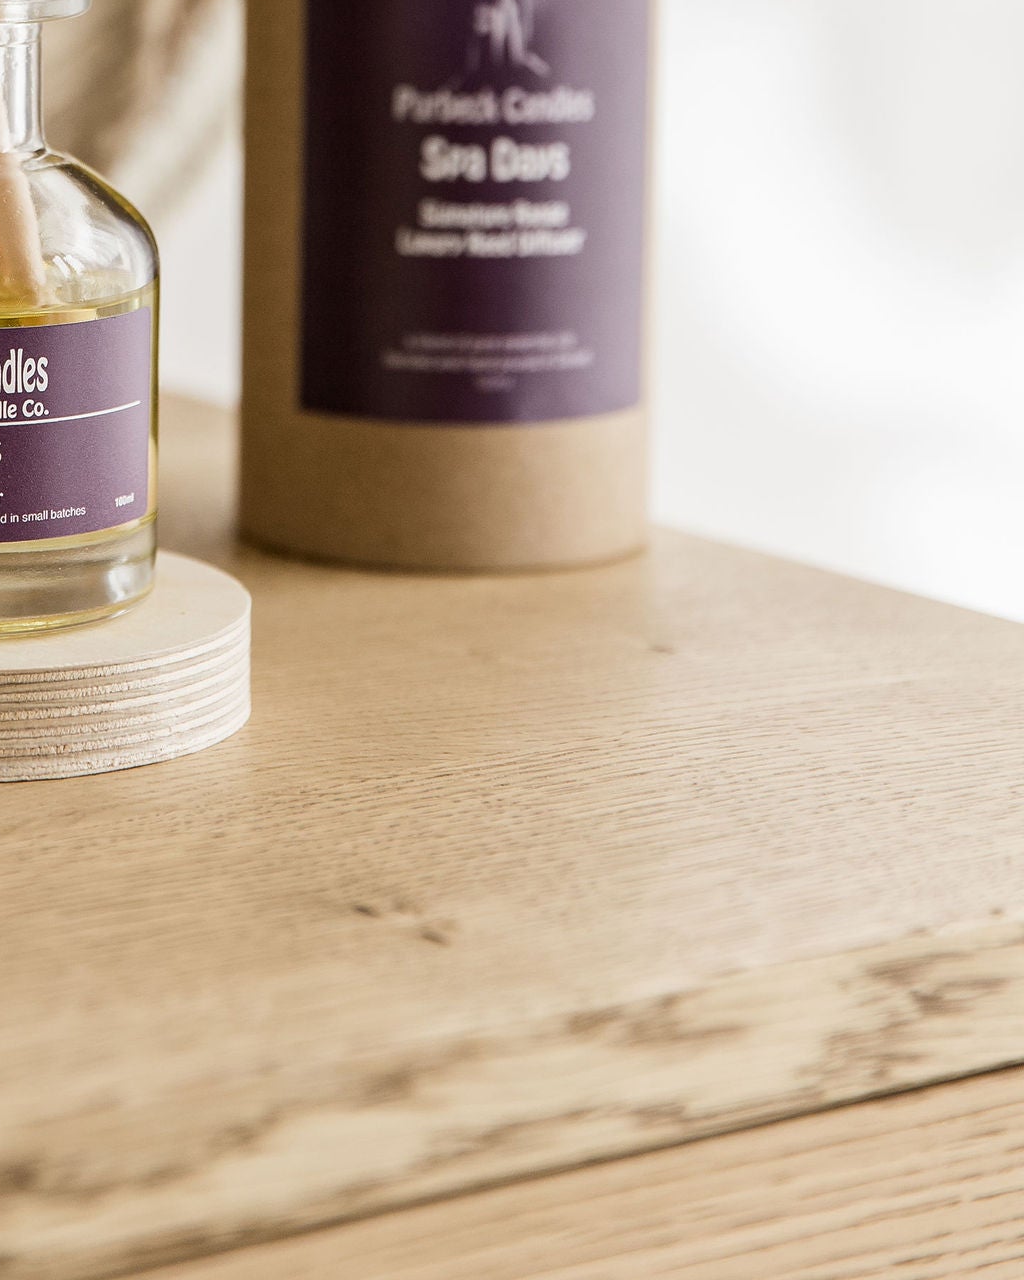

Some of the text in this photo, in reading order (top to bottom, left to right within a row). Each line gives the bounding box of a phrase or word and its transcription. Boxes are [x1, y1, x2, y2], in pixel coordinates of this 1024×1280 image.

[421, 135, 486, 181] Spa
[22, 399, 50, 417] Co.
[10, 512, 19, 523] in
[22, 510, 49, 522] small
[50, 505, 87, 520] batches
